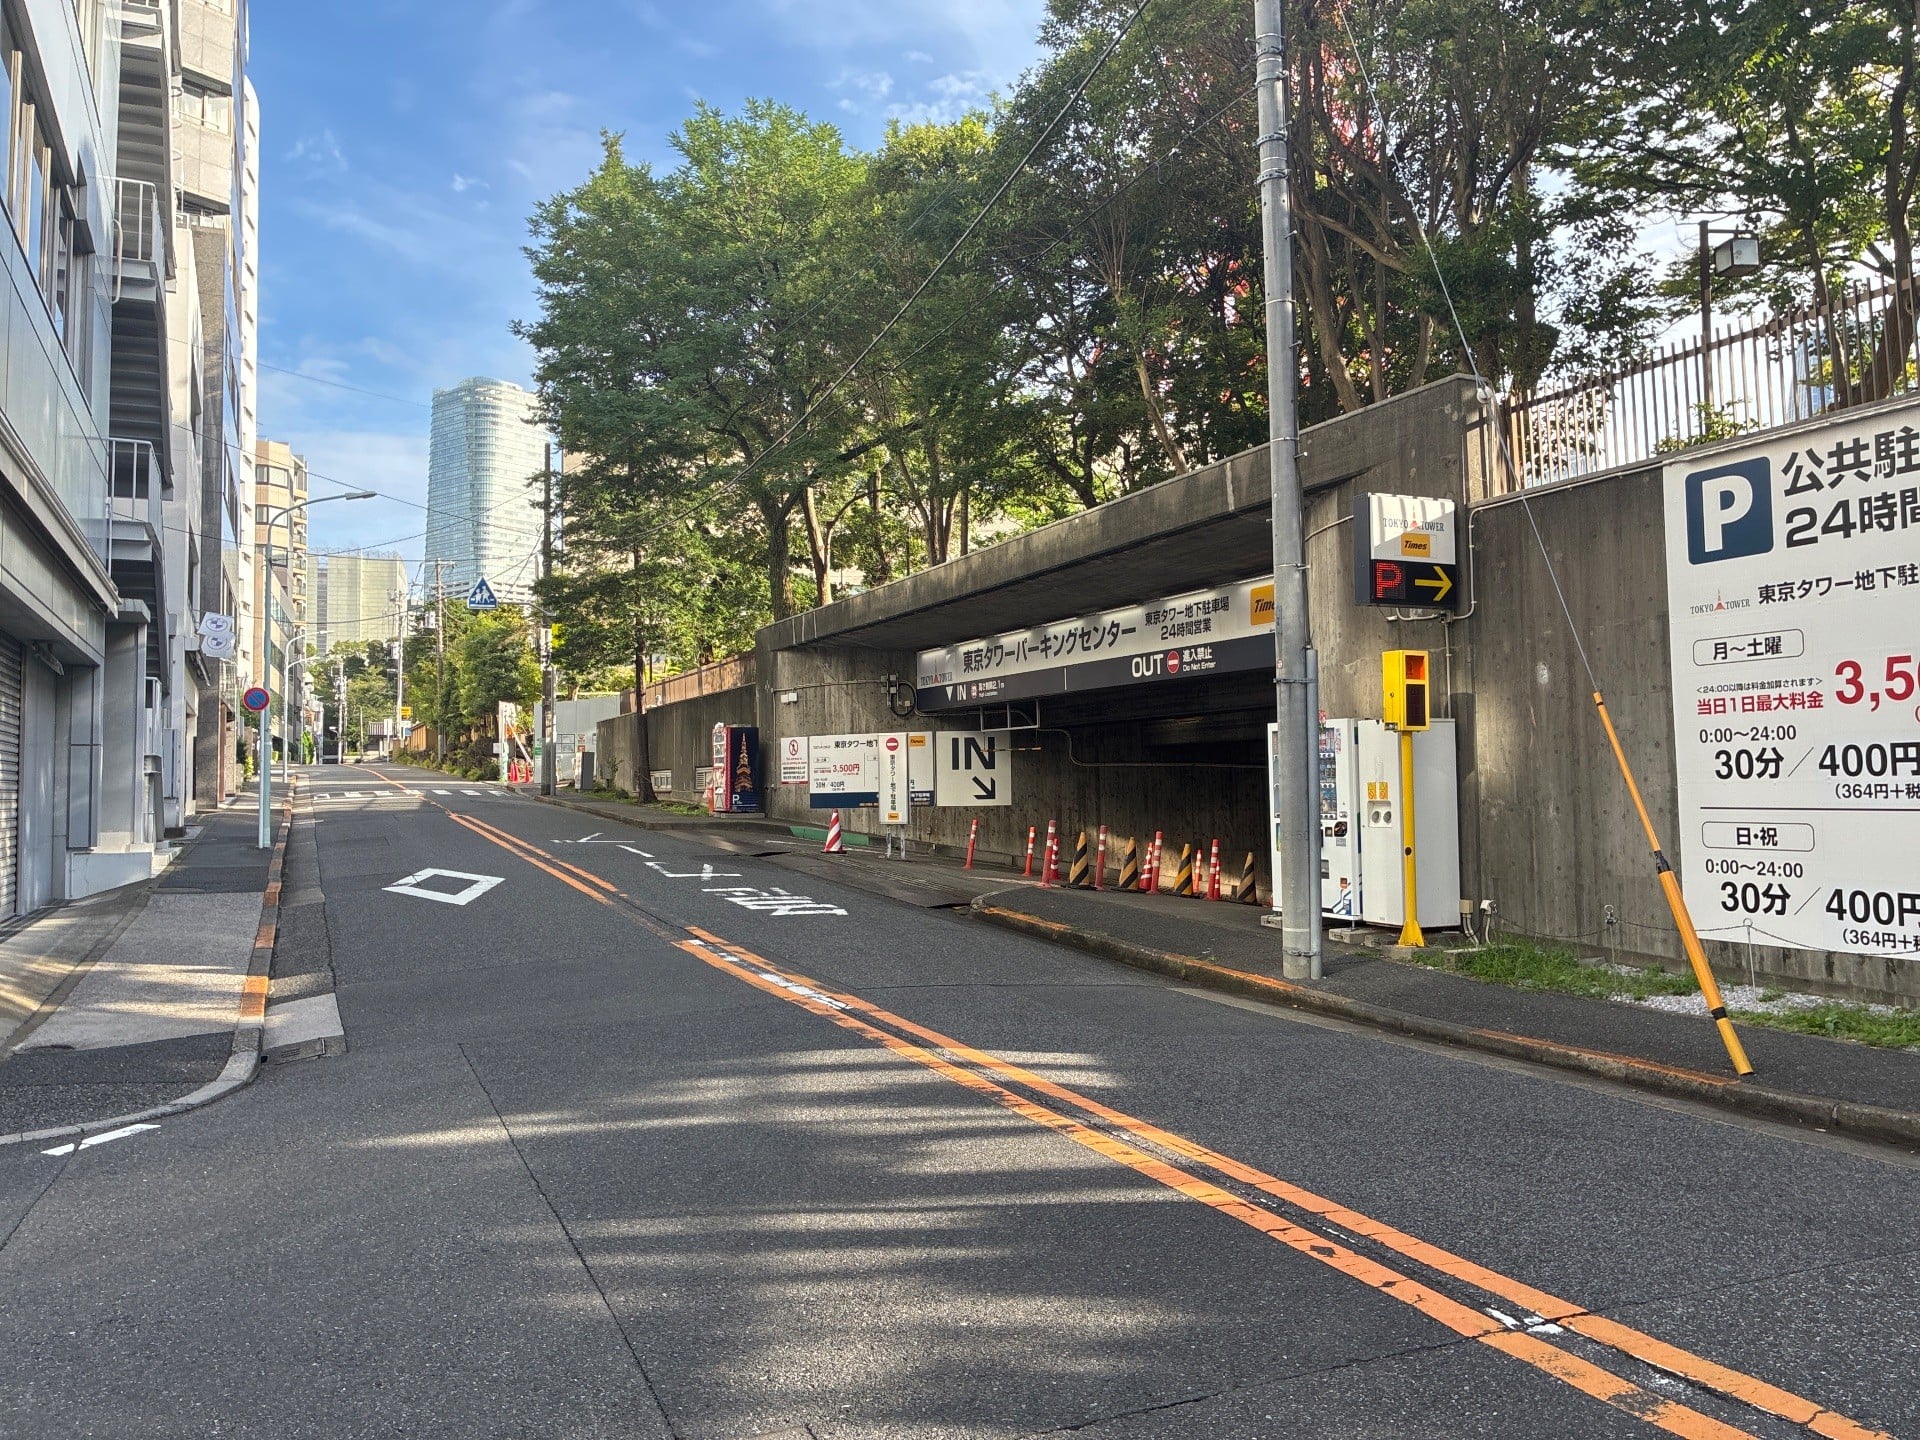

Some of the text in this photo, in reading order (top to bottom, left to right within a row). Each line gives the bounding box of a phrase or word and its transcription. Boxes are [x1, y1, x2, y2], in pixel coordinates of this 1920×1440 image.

[1781, 425, 1920, 498] 公共駐
[1383, 518, 1445, 532] TOKYO TOWER
[1702, 475, 1754, 553] P
[1404, 540, 1428, 550] Times
[1376, 562, 1403, 598] P
[1758, 563, 1920, 605] 東京タワー地下駐
[1144, 596, 1230, 626] 東京タワー地下駐車場
[1254, 599, 1275, 614] Tim
[1690, 598, 1750, 615] TOKYO TOWER
[1160, 618, 1212, 641] 24時間営業
[963, 620, 1137, 674] 東京タワーパーキングセンター
[1182, 646, 1213, 663] 進入禁止
[1131, 653, 1164, 678] OUT
[1182, 661, 1217, 672] Do Not Enter
[956, 684, 967, 702] IN
[1835, 655, 1920, 712] 3,5
[1697, 690, 1824, 715] 当日1日最大料金
[951, 736, 996, 771] IN
[832, 763, 860, 774] 3,500円
[1736, 827, 1778, 847] 日・祝
